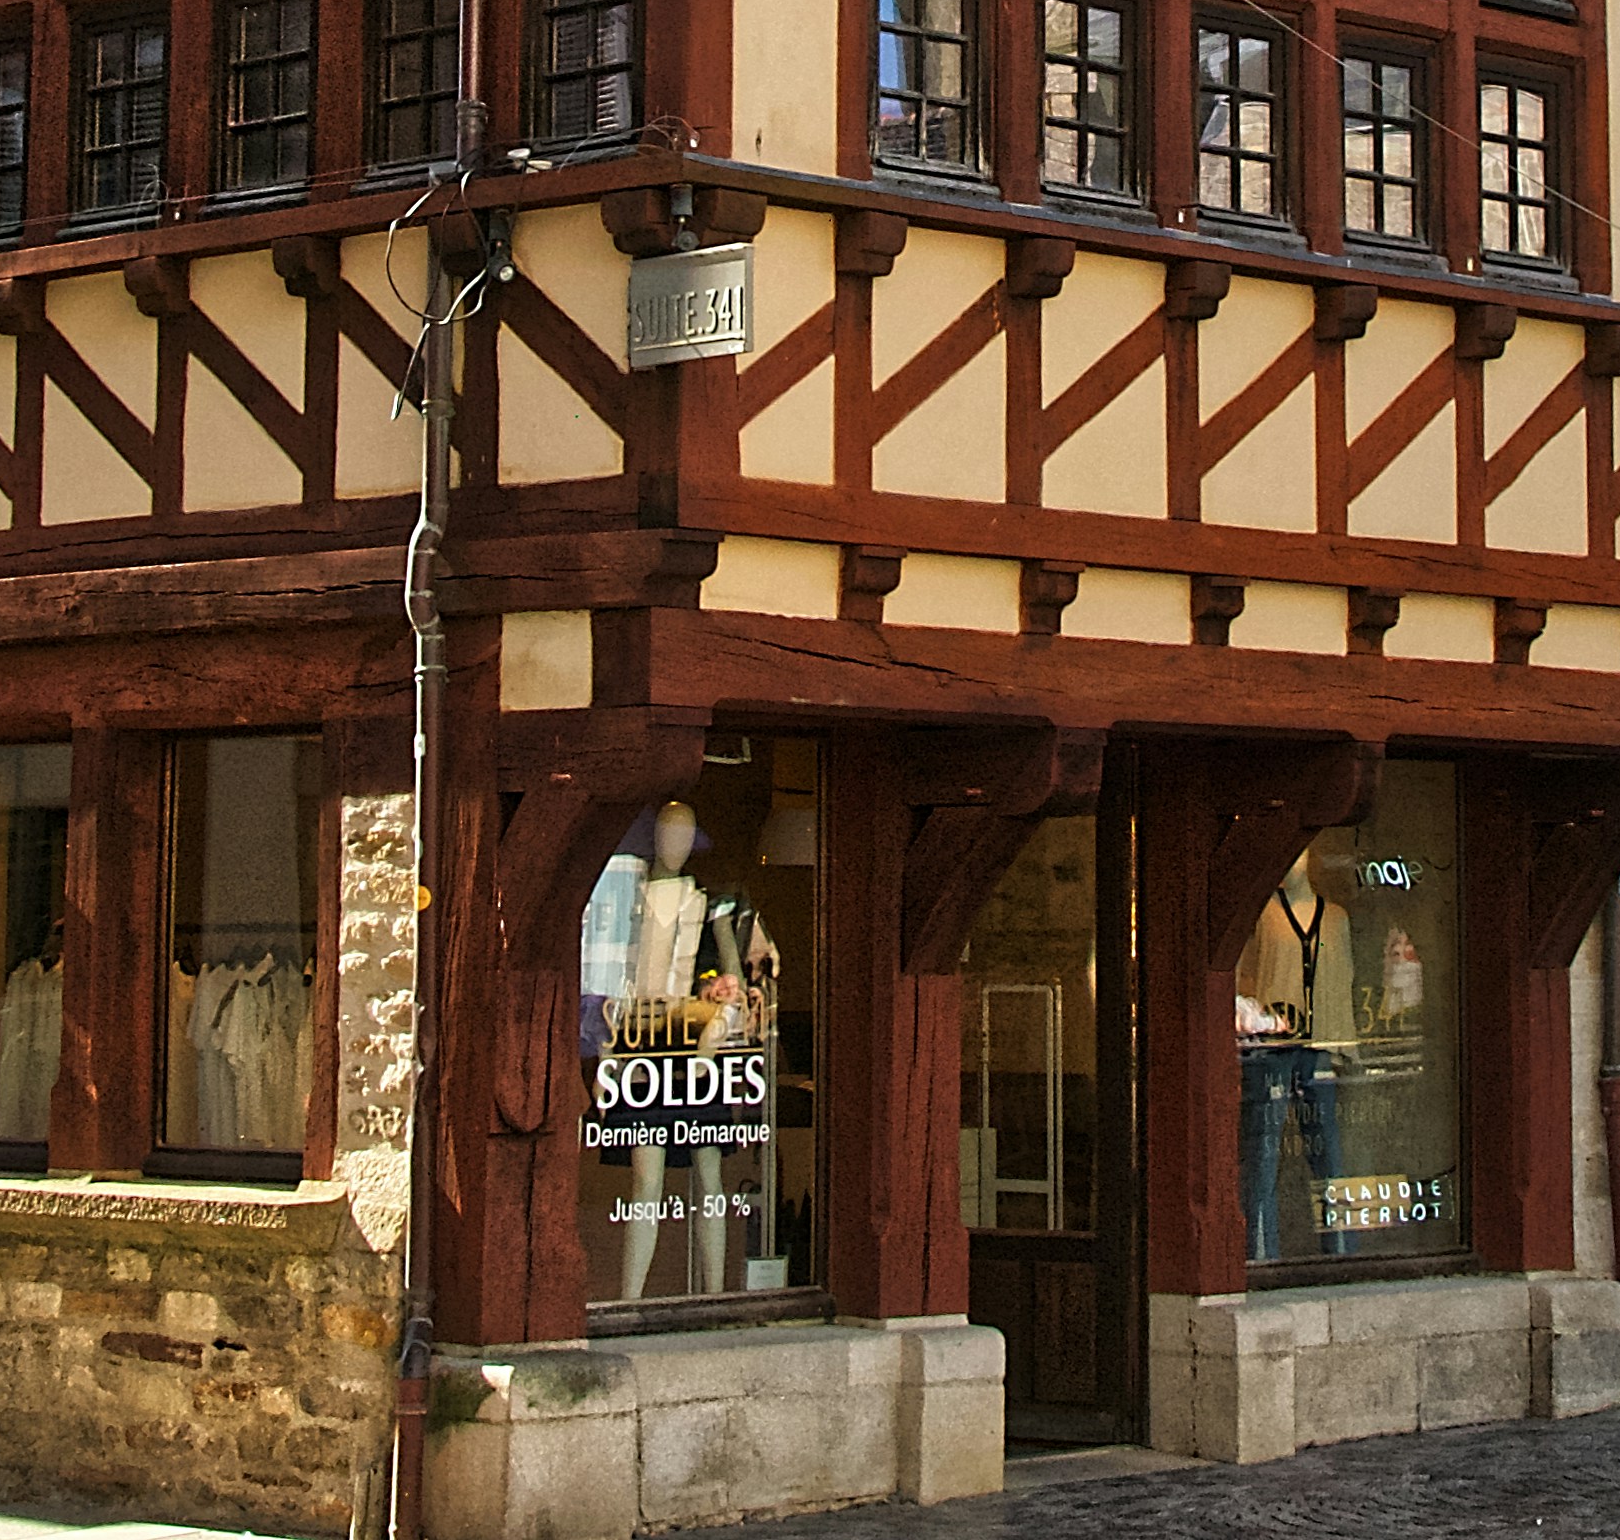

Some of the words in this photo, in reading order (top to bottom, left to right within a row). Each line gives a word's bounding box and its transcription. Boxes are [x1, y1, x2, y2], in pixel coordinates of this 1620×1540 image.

[633, 285, 743, 343] SUITE.341
[597, 1055, 766, 1109] SOLDES
[586, 1121, 668, 1147] Dernière
[674, 1120, 770, 1148] Démarque
[1325, 1179, 1442, 1203] CLAUDIE
[609, 1195, 684, 1225] Jusqu'à
[703, 1194, 726, 1218] 50
[732, 1193, 751, 1217] %
[1326, 1203, 1442, 1226] PIERLOT
